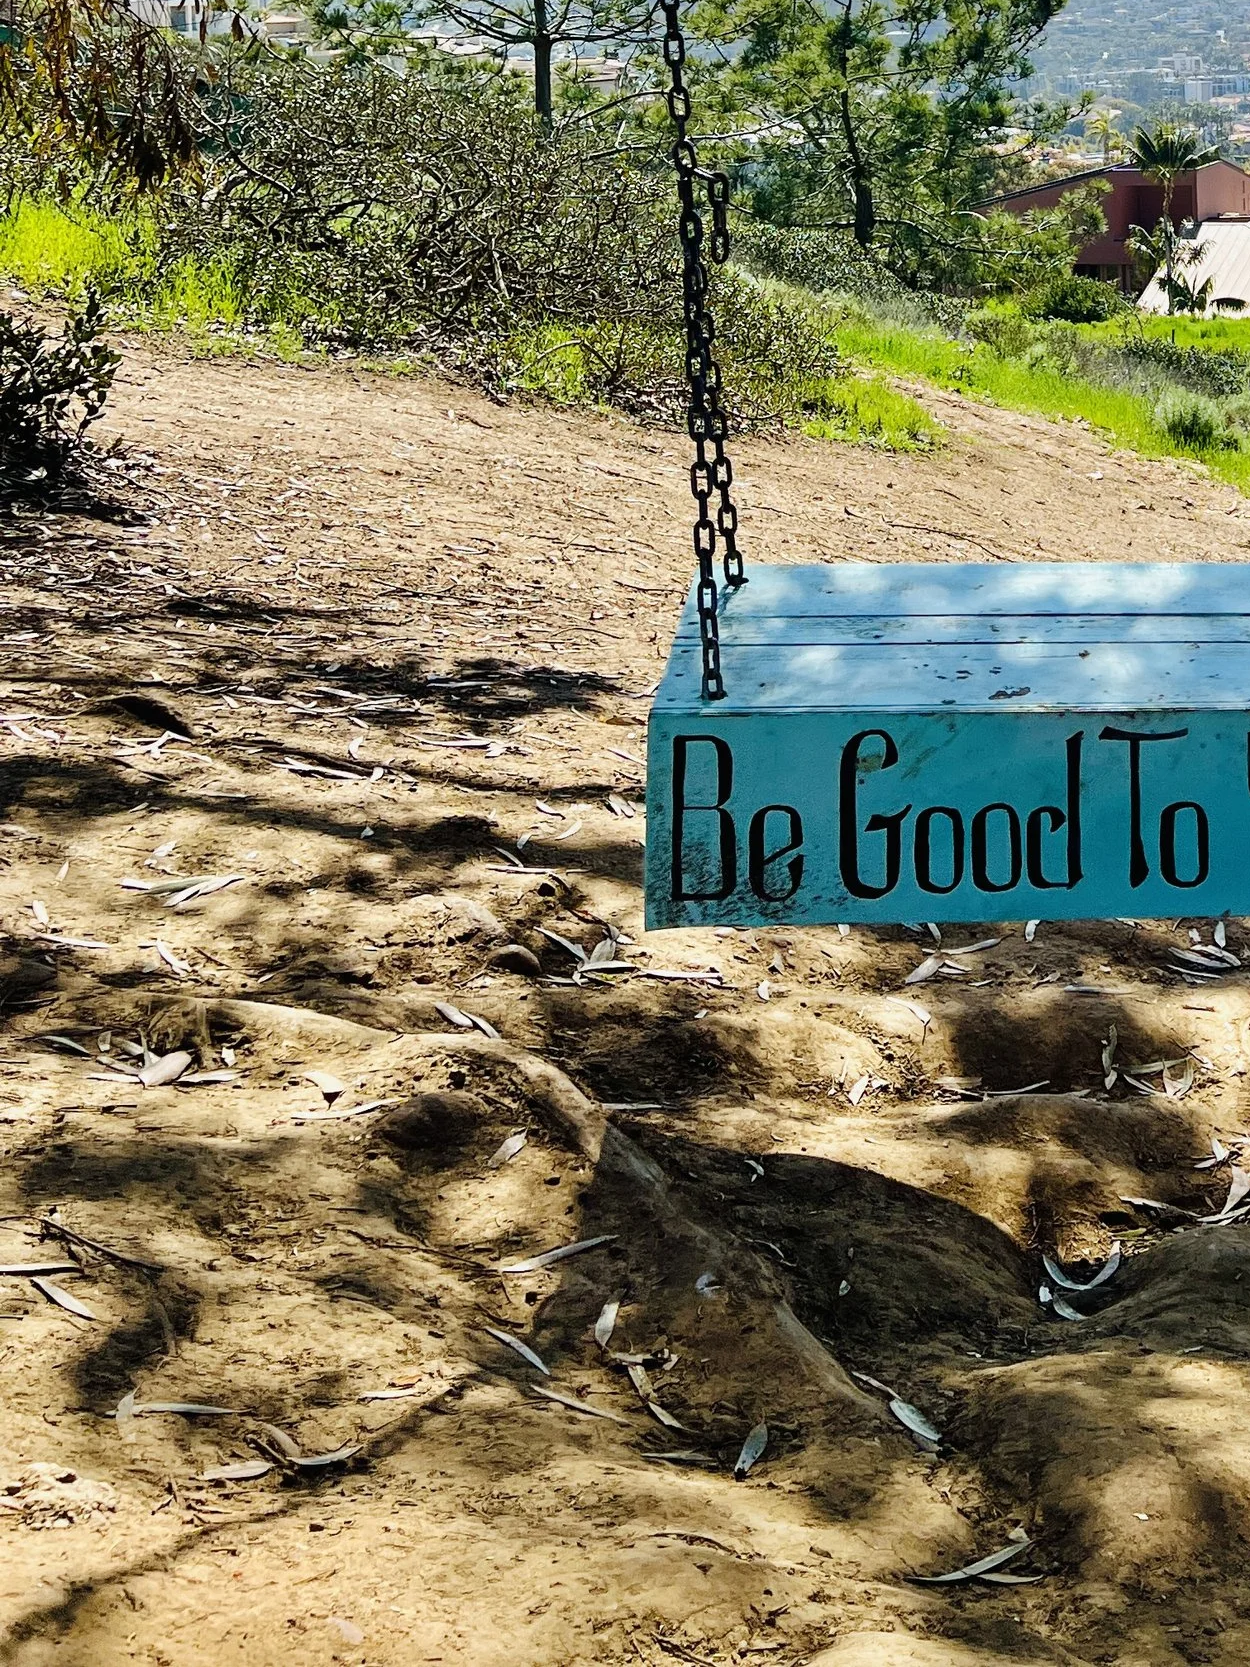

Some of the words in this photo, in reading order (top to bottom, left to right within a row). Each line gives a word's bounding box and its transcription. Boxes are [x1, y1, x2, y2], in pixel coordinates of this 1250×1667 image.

[670, 733, 803, 901] Be
[839, 728, 1085, 900] Good
[1098, 725, 1209, 889] To
